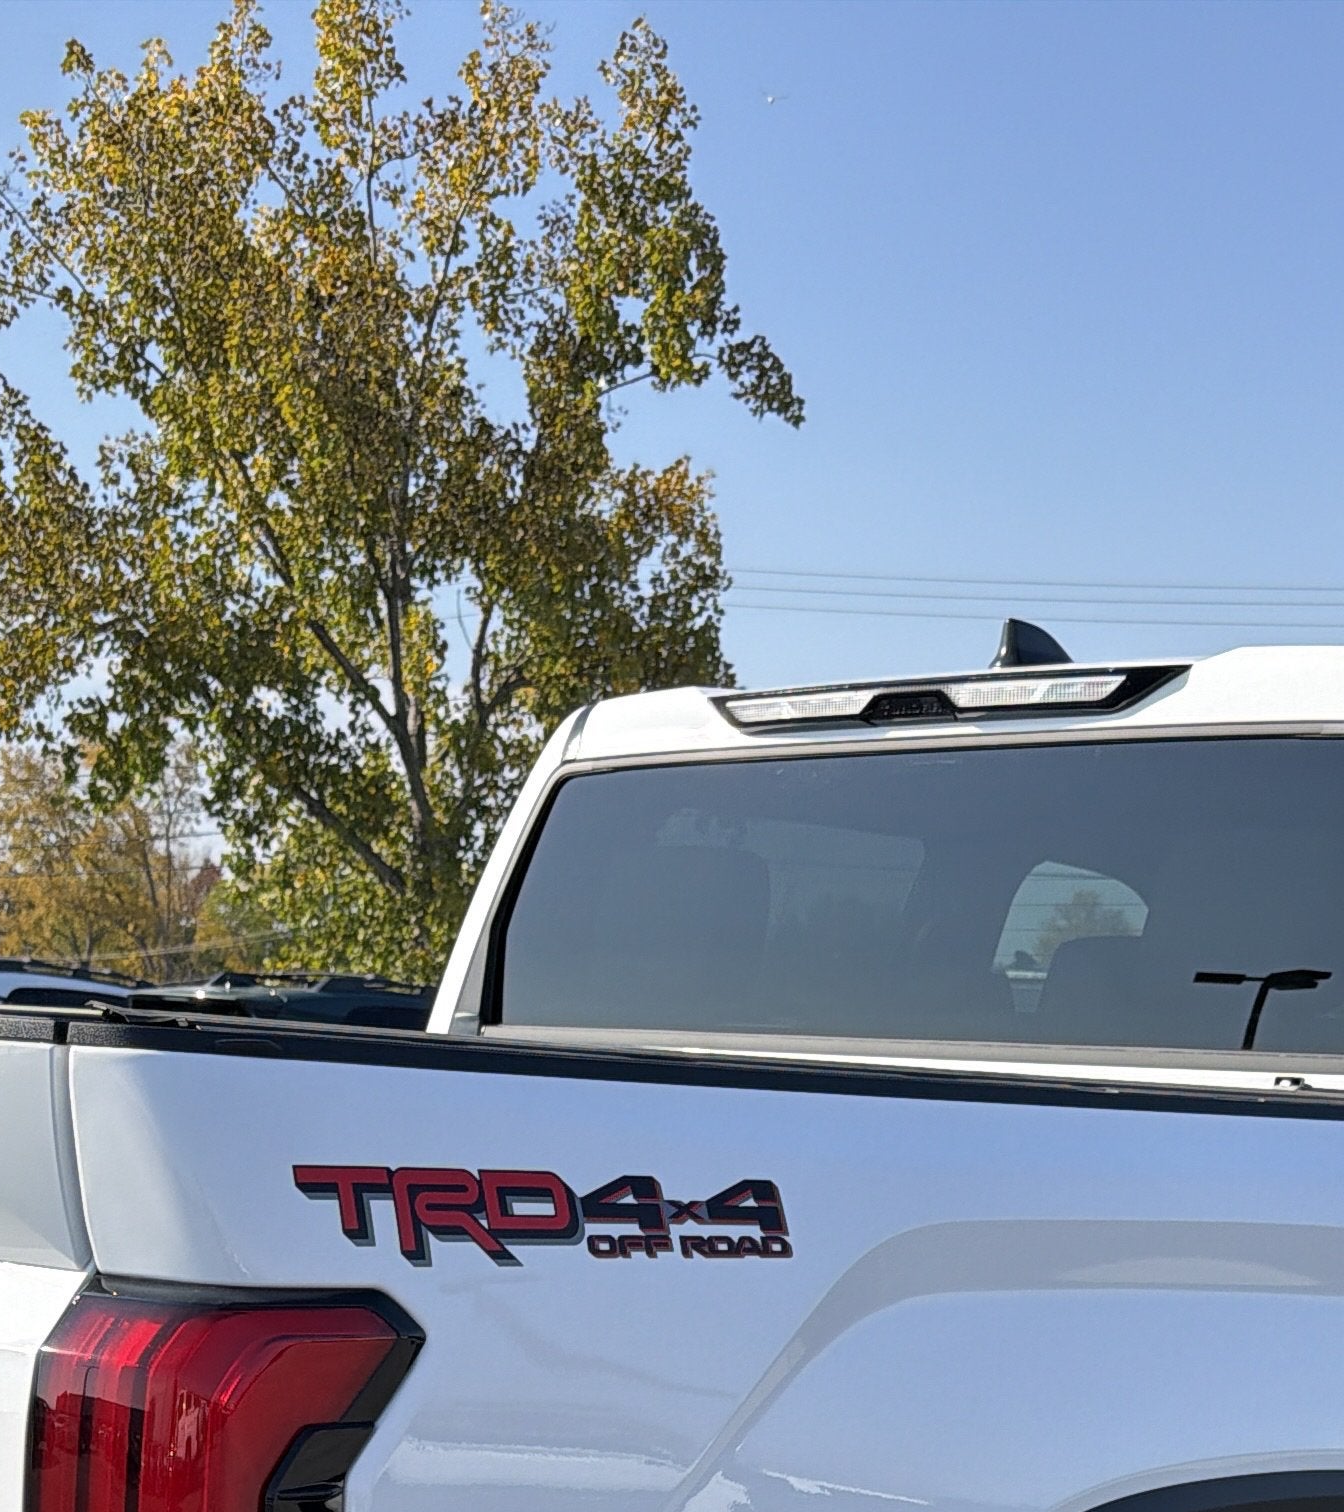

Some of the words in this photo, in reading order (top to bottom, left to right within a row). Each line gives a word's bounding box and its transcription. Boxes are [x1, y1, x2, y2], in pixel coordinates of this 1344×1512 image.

[291, 1164, 584, 1268] TRD
[586, 1234, 674, 1259] OFF
[679, 1234, 794, 1259] ROAD
